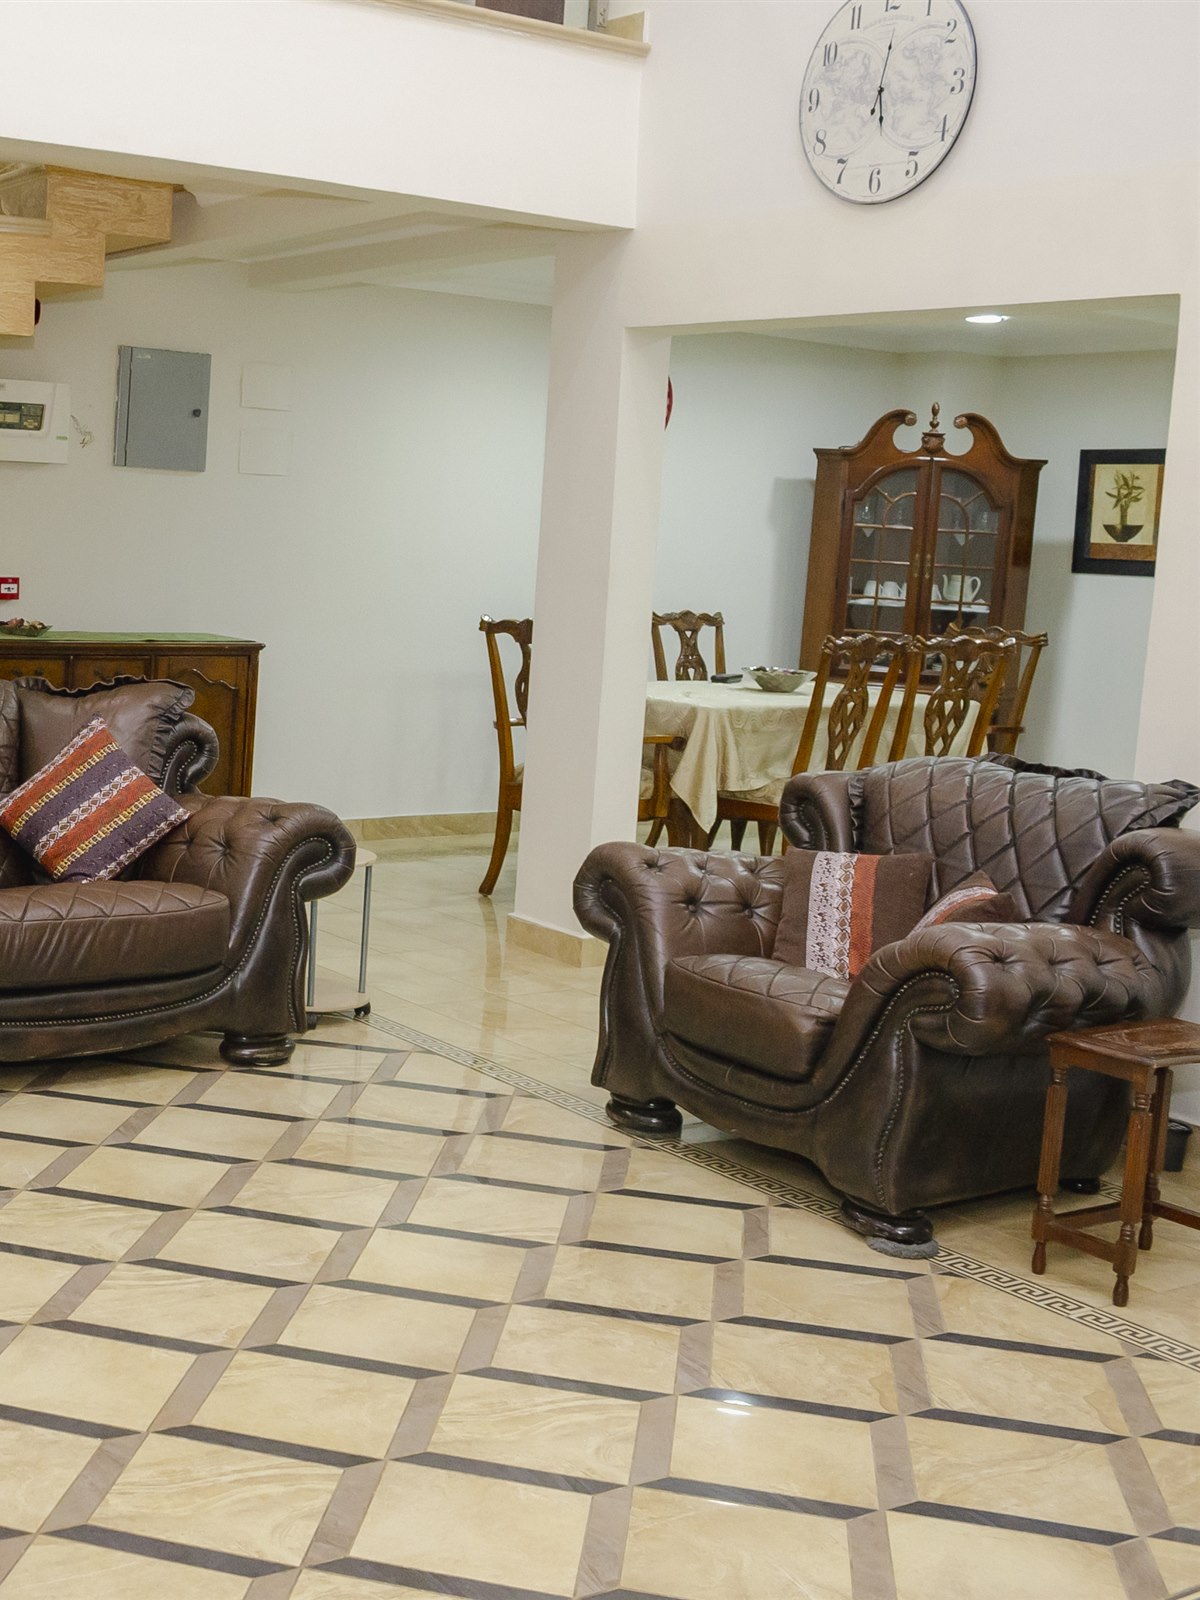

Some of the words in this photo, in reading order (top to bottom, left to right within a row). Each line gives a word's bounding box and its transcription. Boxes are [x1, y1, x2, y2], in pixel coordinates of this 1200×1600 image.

[850, 4, 862, 30] 11
[945, 18, 958, 44] 2
[822, 41, 838, 67] 10
[950, 68, 965, 95] 3
[808, 88, 820, 113] 9
[934, 114, 949, 142] 4
[813, 129, 827, 155] 8
[836, 157, 848, 184] 7
[905, 151, 919, 178] 5
[868, 167, 881, 194] 6
